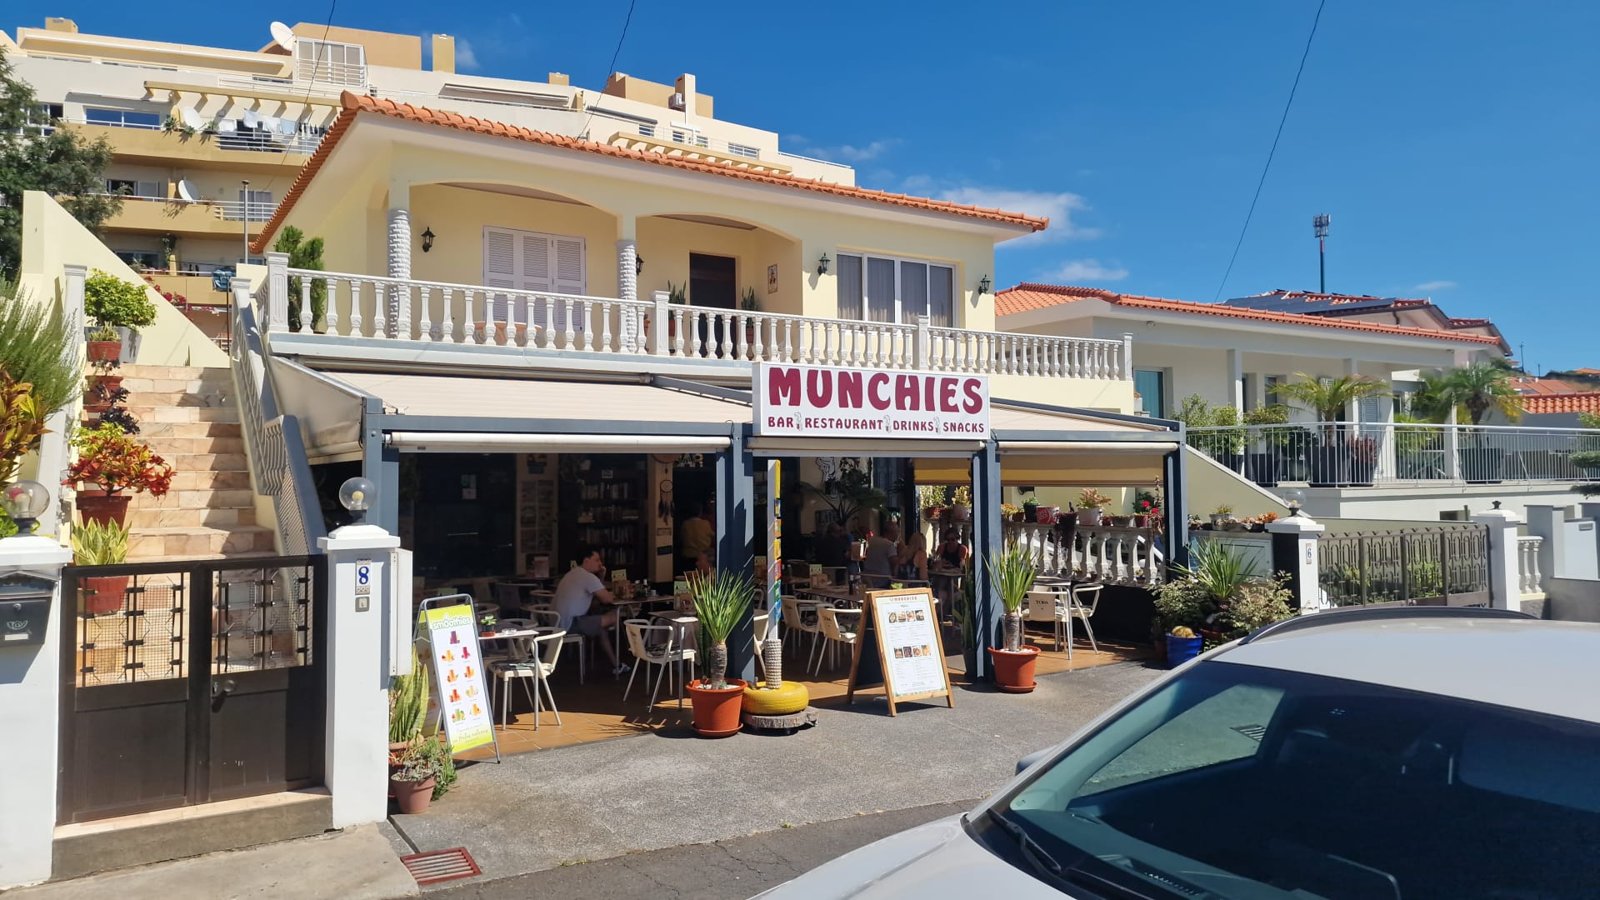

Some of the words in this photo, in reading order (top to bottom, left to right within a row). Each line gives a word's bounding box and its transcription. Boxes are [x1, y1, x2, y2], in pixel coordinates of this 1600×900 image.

[768, 367, 983, 415] MUNCHIES
[768, 416, 793, 428] BAR
[804, 417, 883, 430] RESTAURANT
[893, 420, 934, 432] DRINKS
[943, 421, 985, 433] SNACKS
[359, 566, 369, 584] 8
